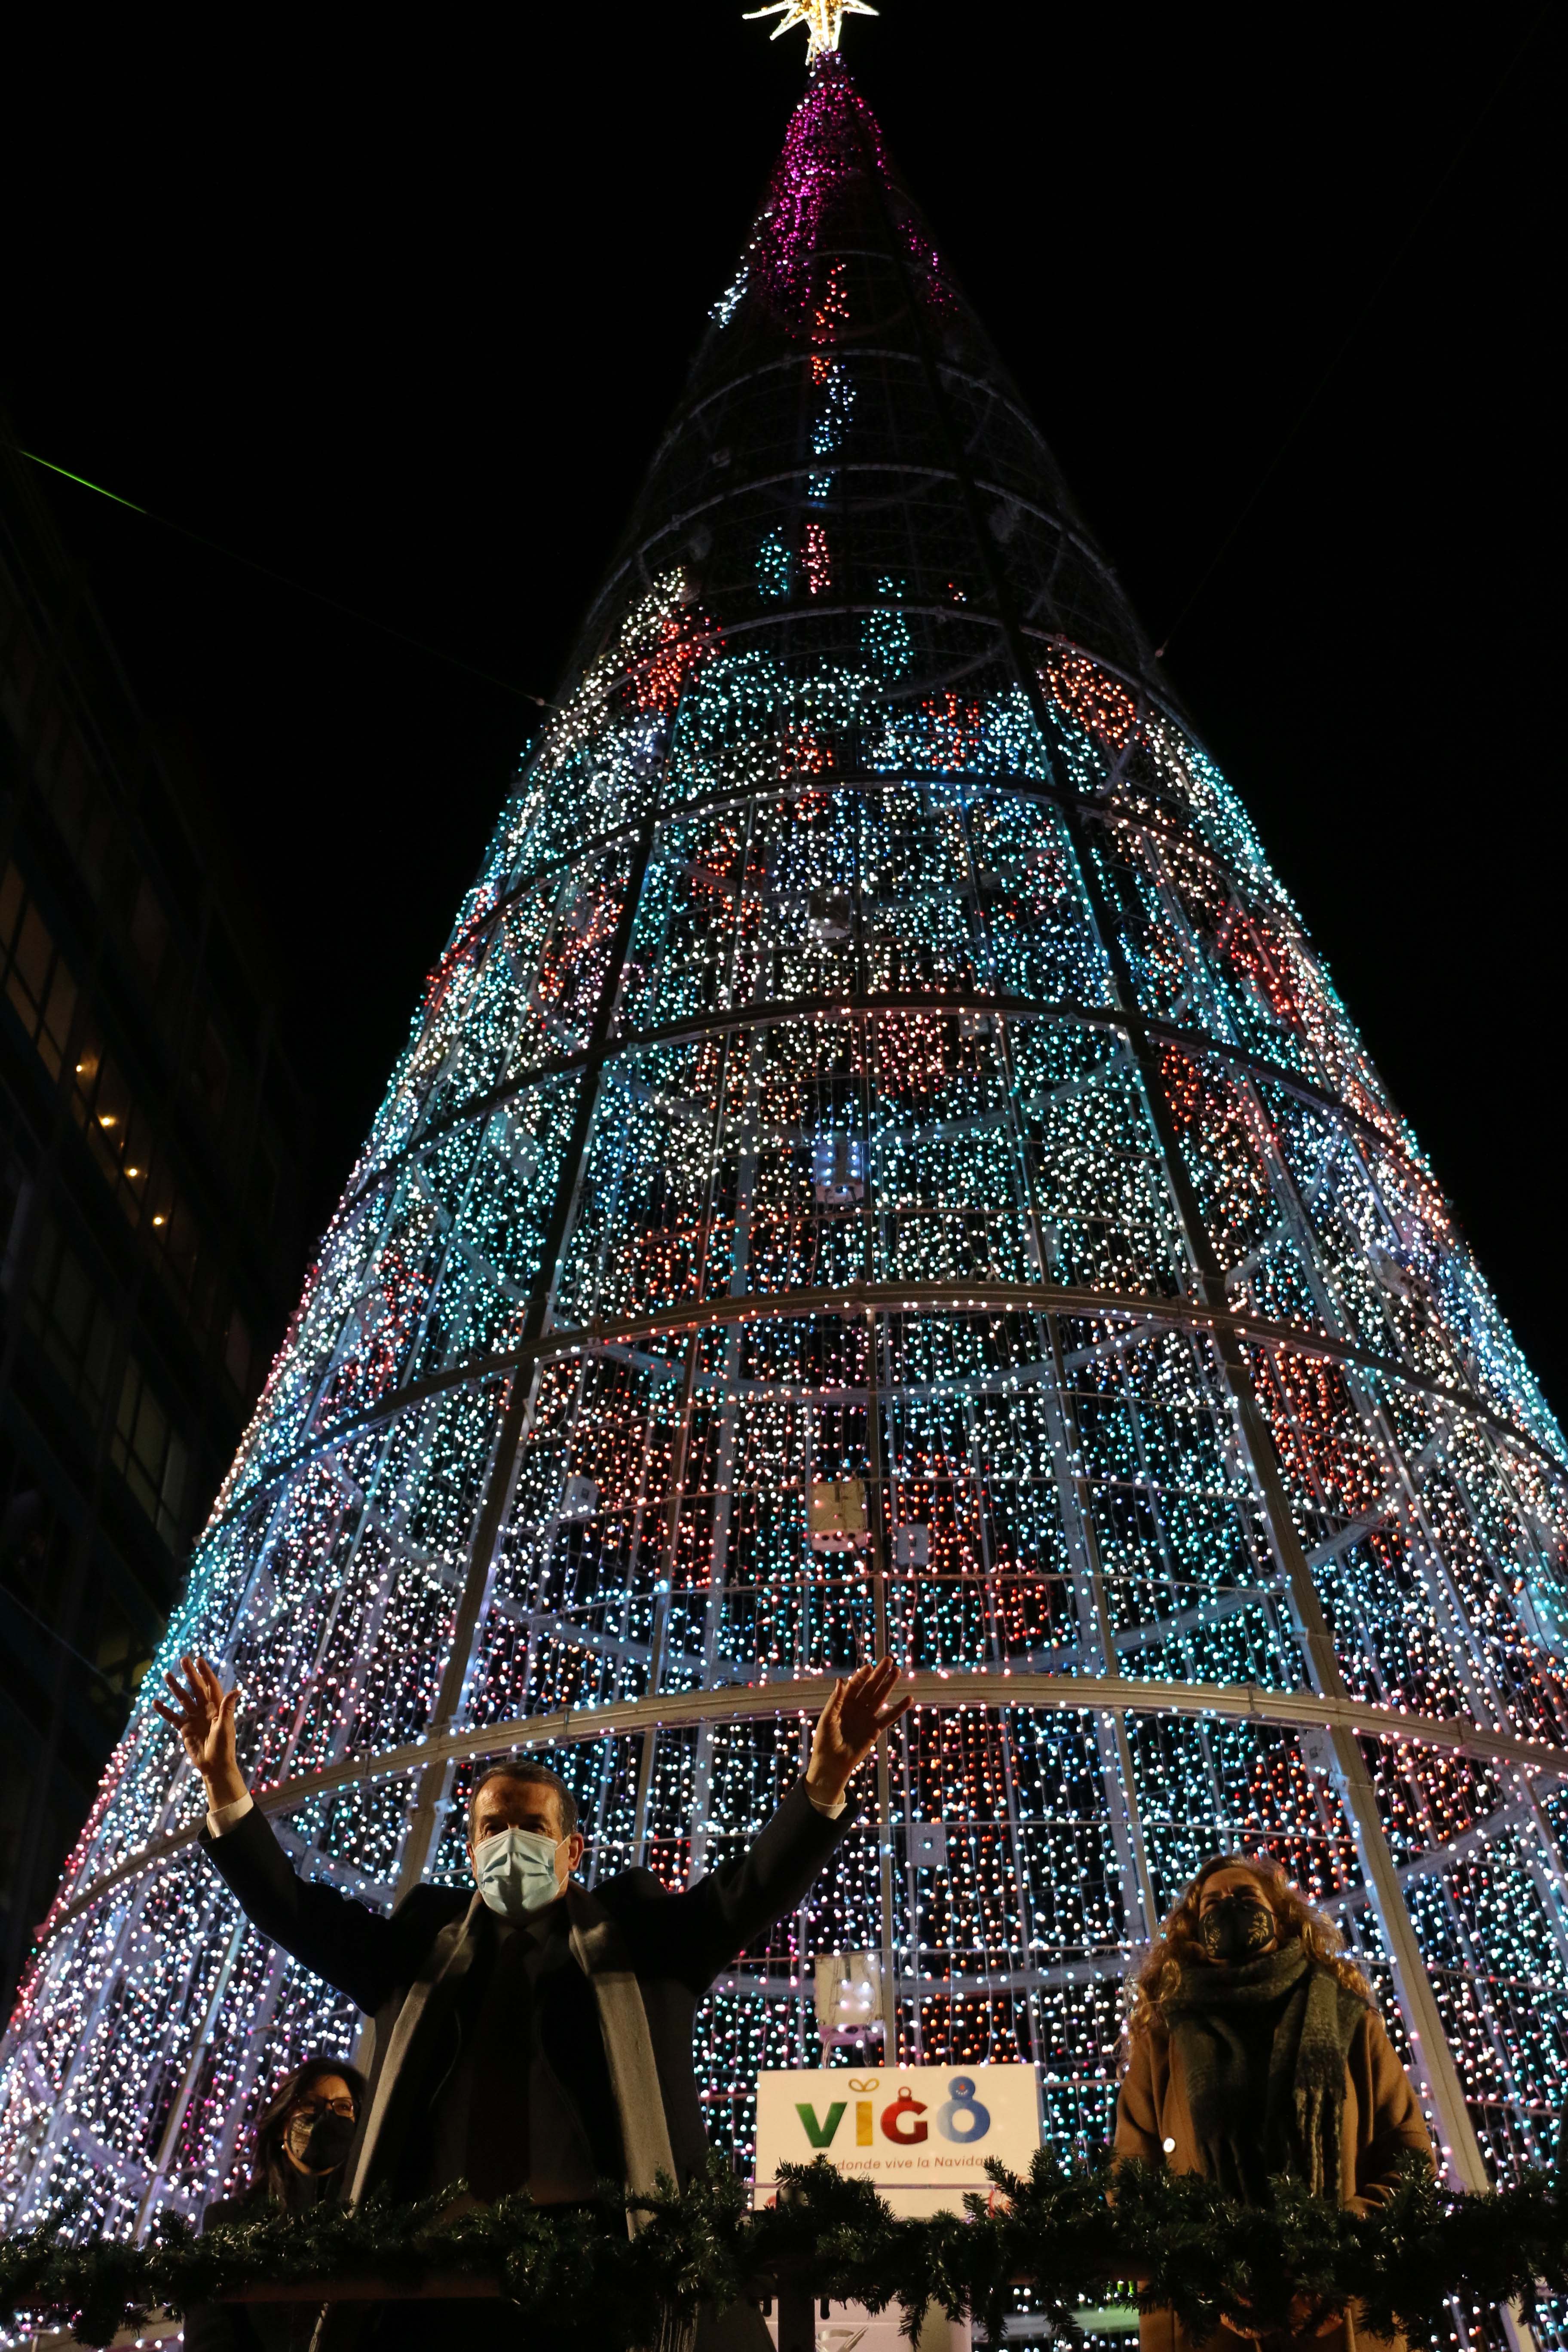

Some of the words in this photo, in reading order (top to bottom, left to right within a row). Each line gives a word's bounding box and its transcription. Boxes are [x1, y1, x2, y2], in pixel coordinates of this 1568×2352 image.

[837, 2158, 881, 2171] donde
[885, 2157, 913, 2168] vive
[917, 2156, 929, 2168] la
[934, 2154, 994, 2167] Navida
